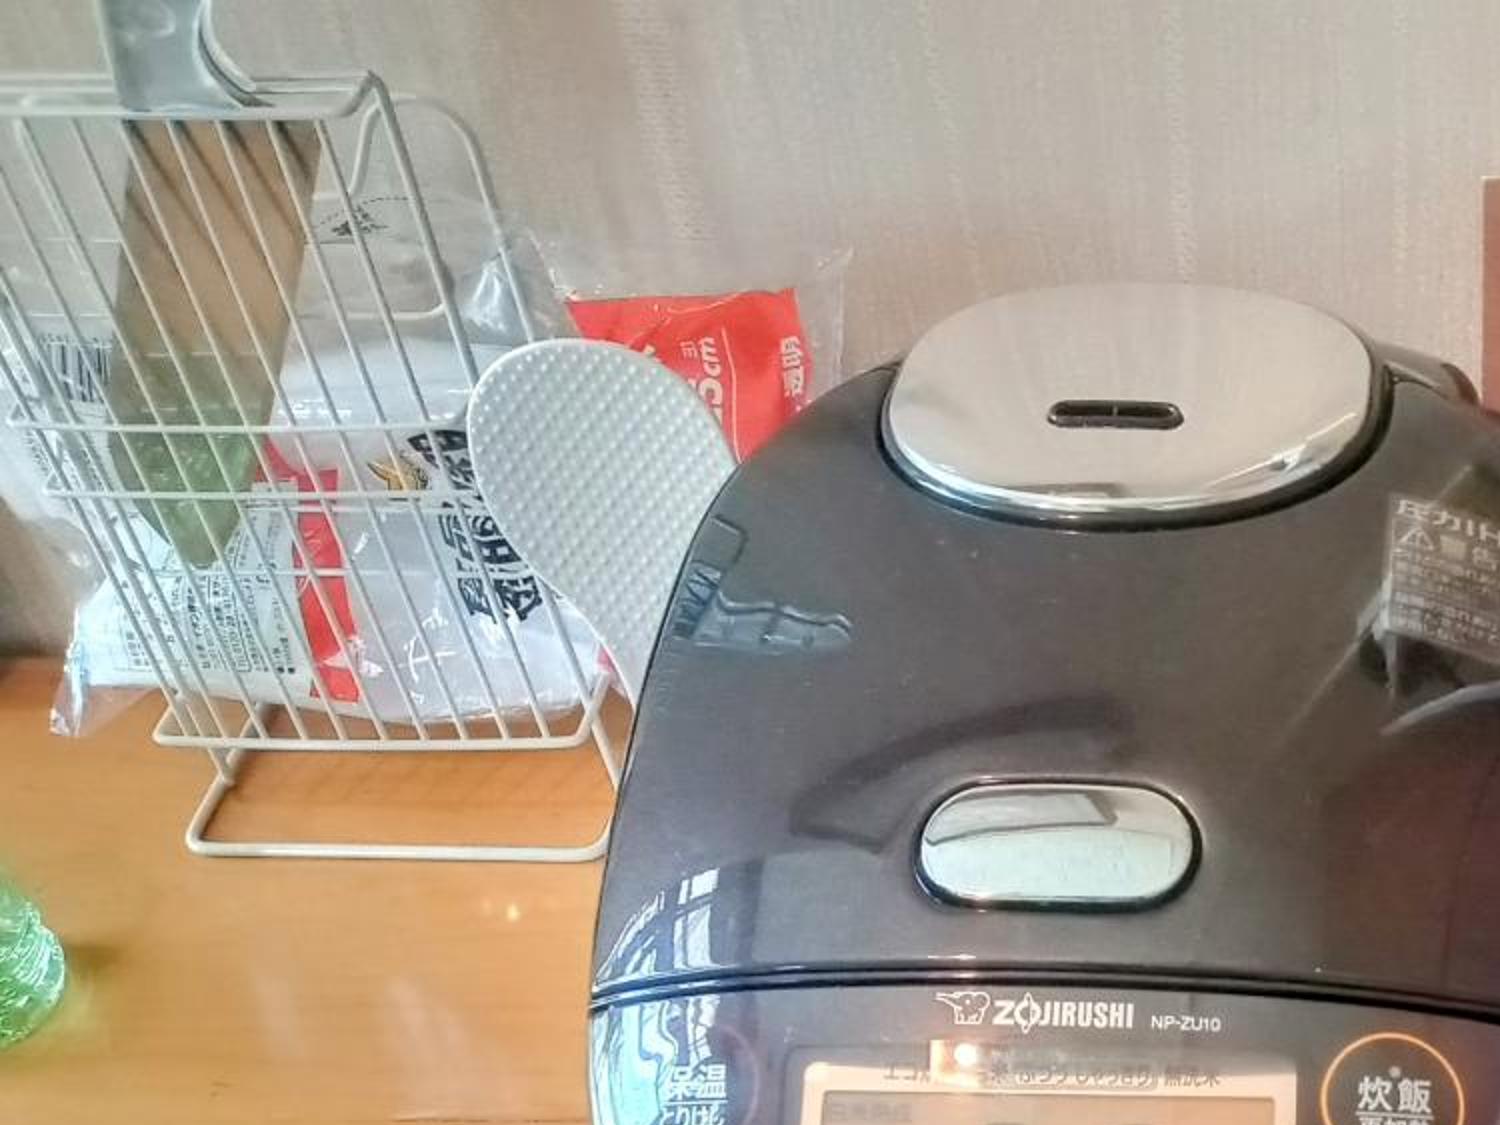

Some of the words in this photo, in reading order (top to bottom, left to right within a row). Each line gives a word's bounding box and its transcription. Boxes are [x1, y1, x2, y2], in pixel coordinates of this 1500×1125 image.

[992, 994, 1135, 1033] ZOJIRUSHI
[1150, 1014, 1222, 1033] NP-ZU10
[667, 1063, 728, 1099] 保温
[1358, 1076, 1433, 1114] 炊飯
